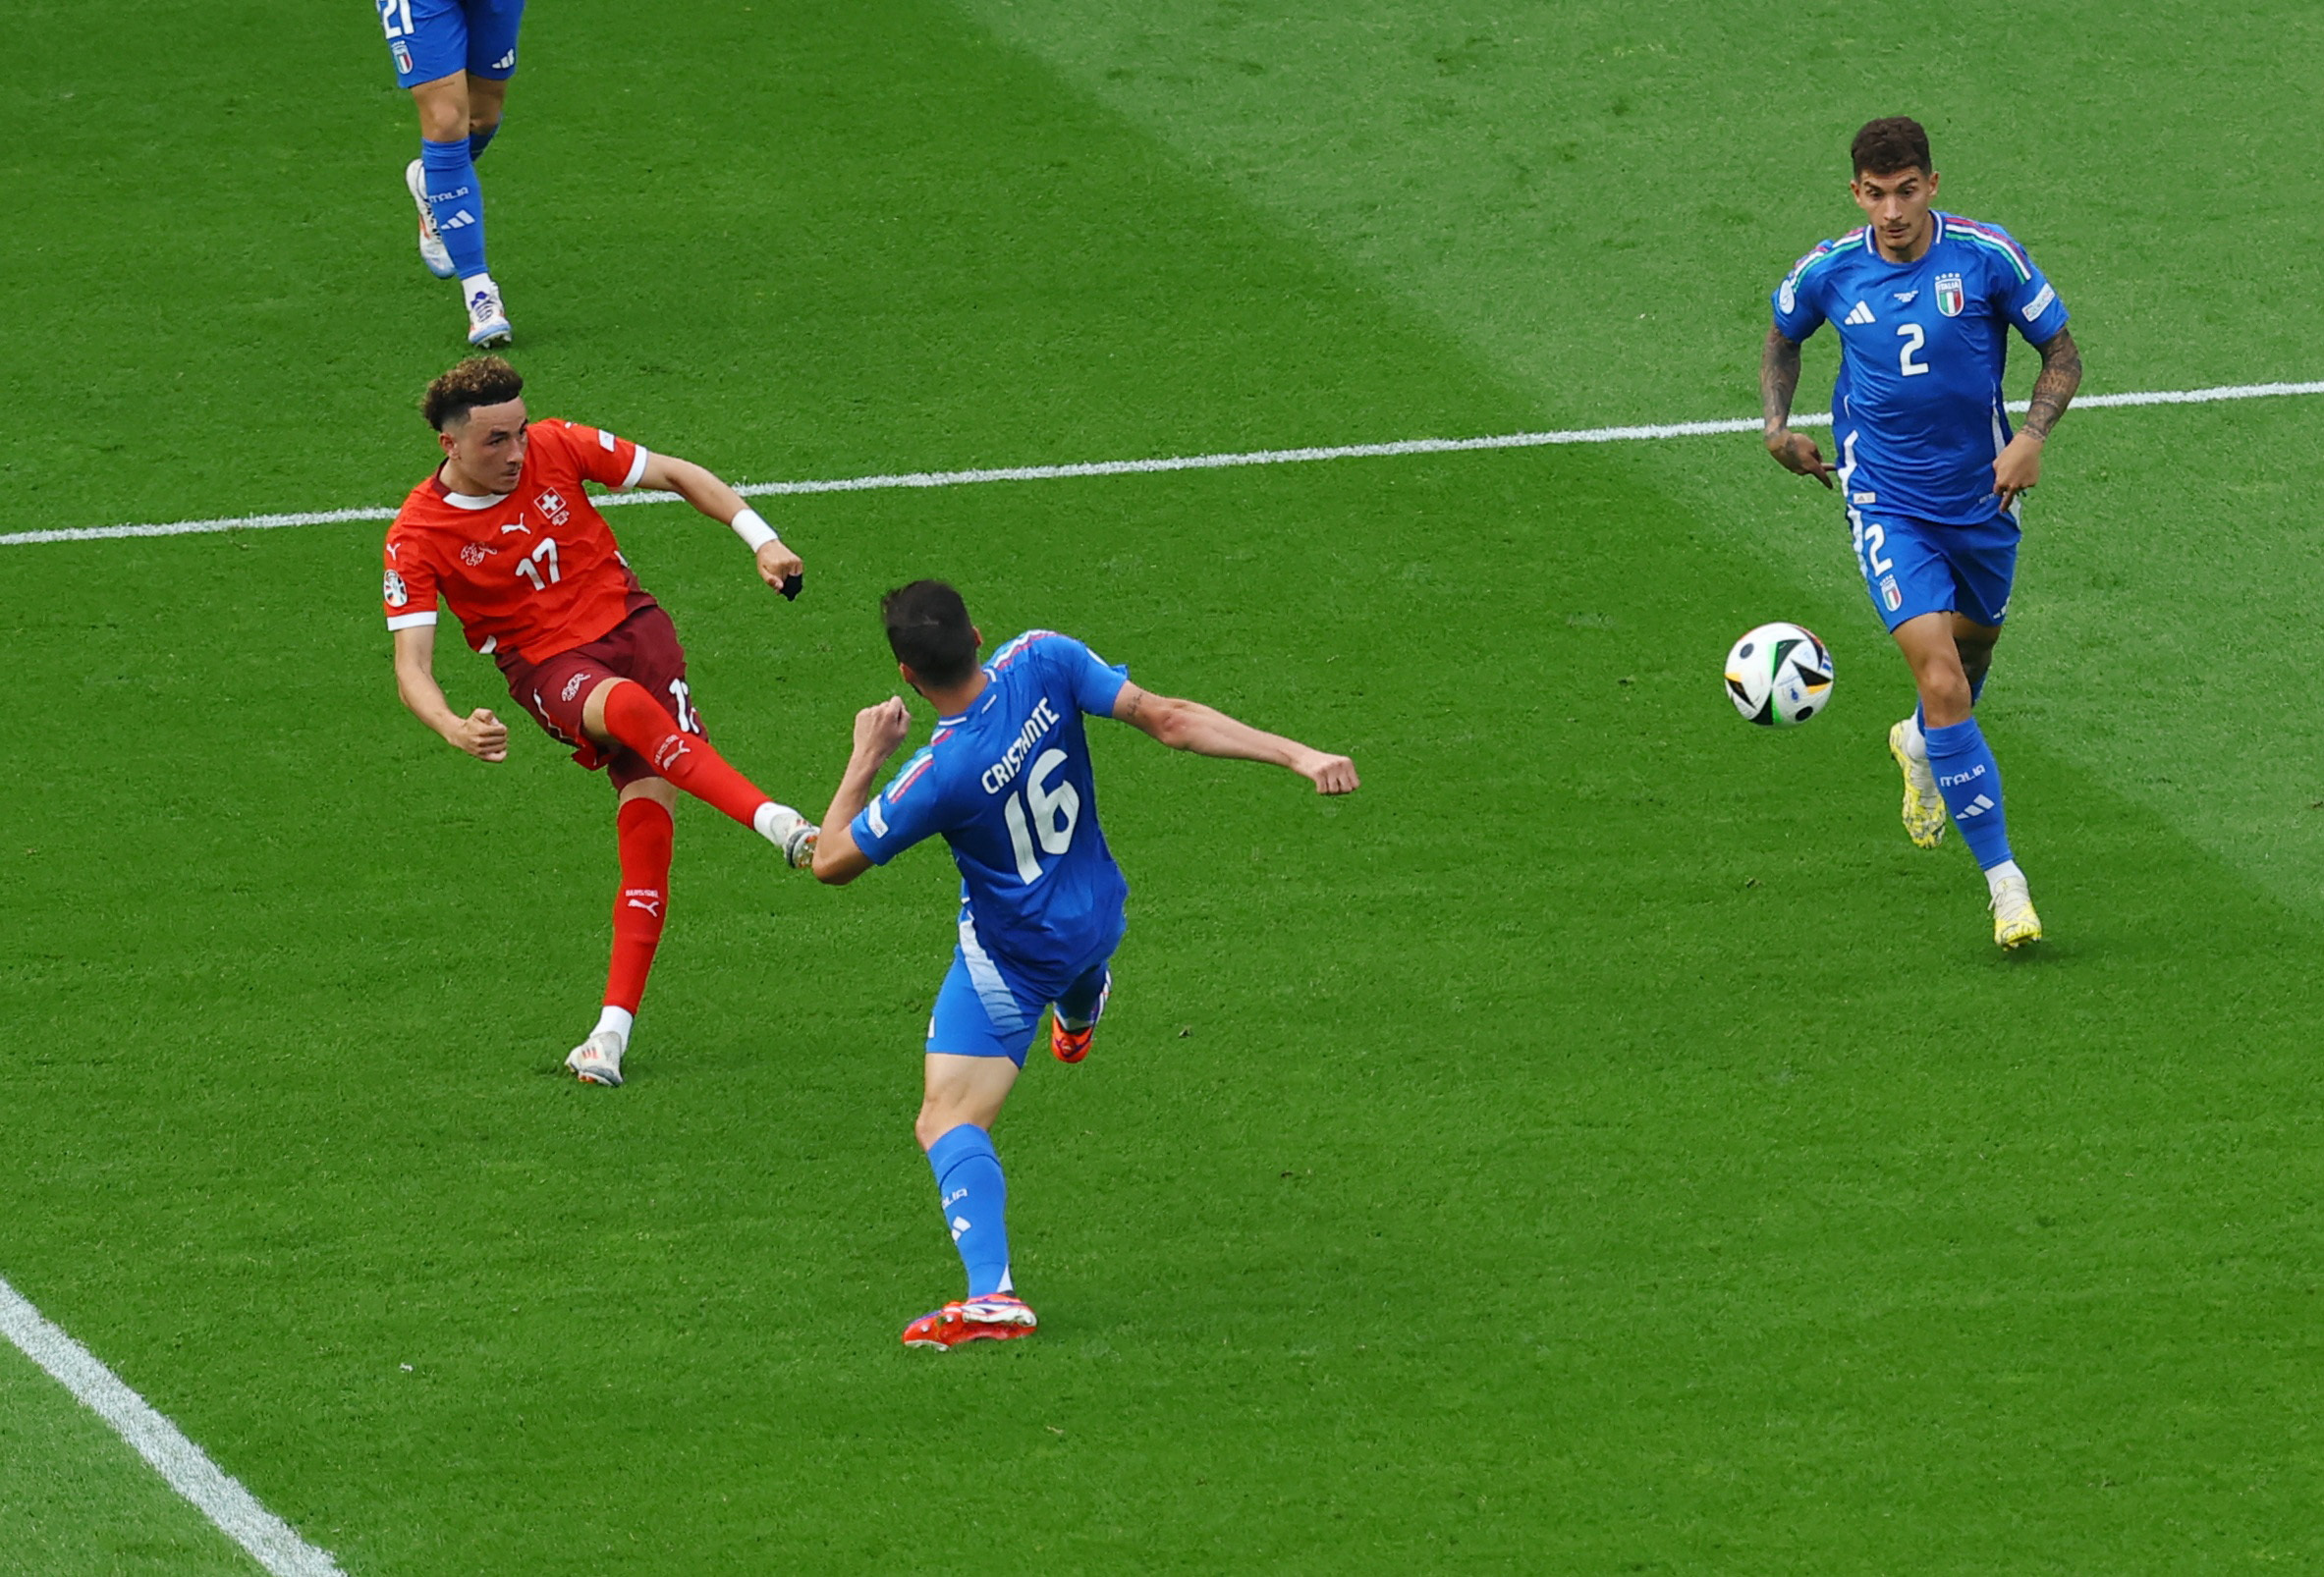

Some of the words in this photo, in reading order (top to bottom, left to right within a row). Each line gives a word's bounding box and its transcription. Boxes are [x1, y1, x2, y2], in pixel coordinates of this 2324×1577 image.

[1896, 322, 1929, 376] 2
[515, 537, 561, 591] 17
[1864, 523, 1894, 577] 2
[981, 696, 1061, 795] CRISTANTE
[1940, 764, 1986, 788] ITALIA
[1004, 747, 1079, 886] 16
